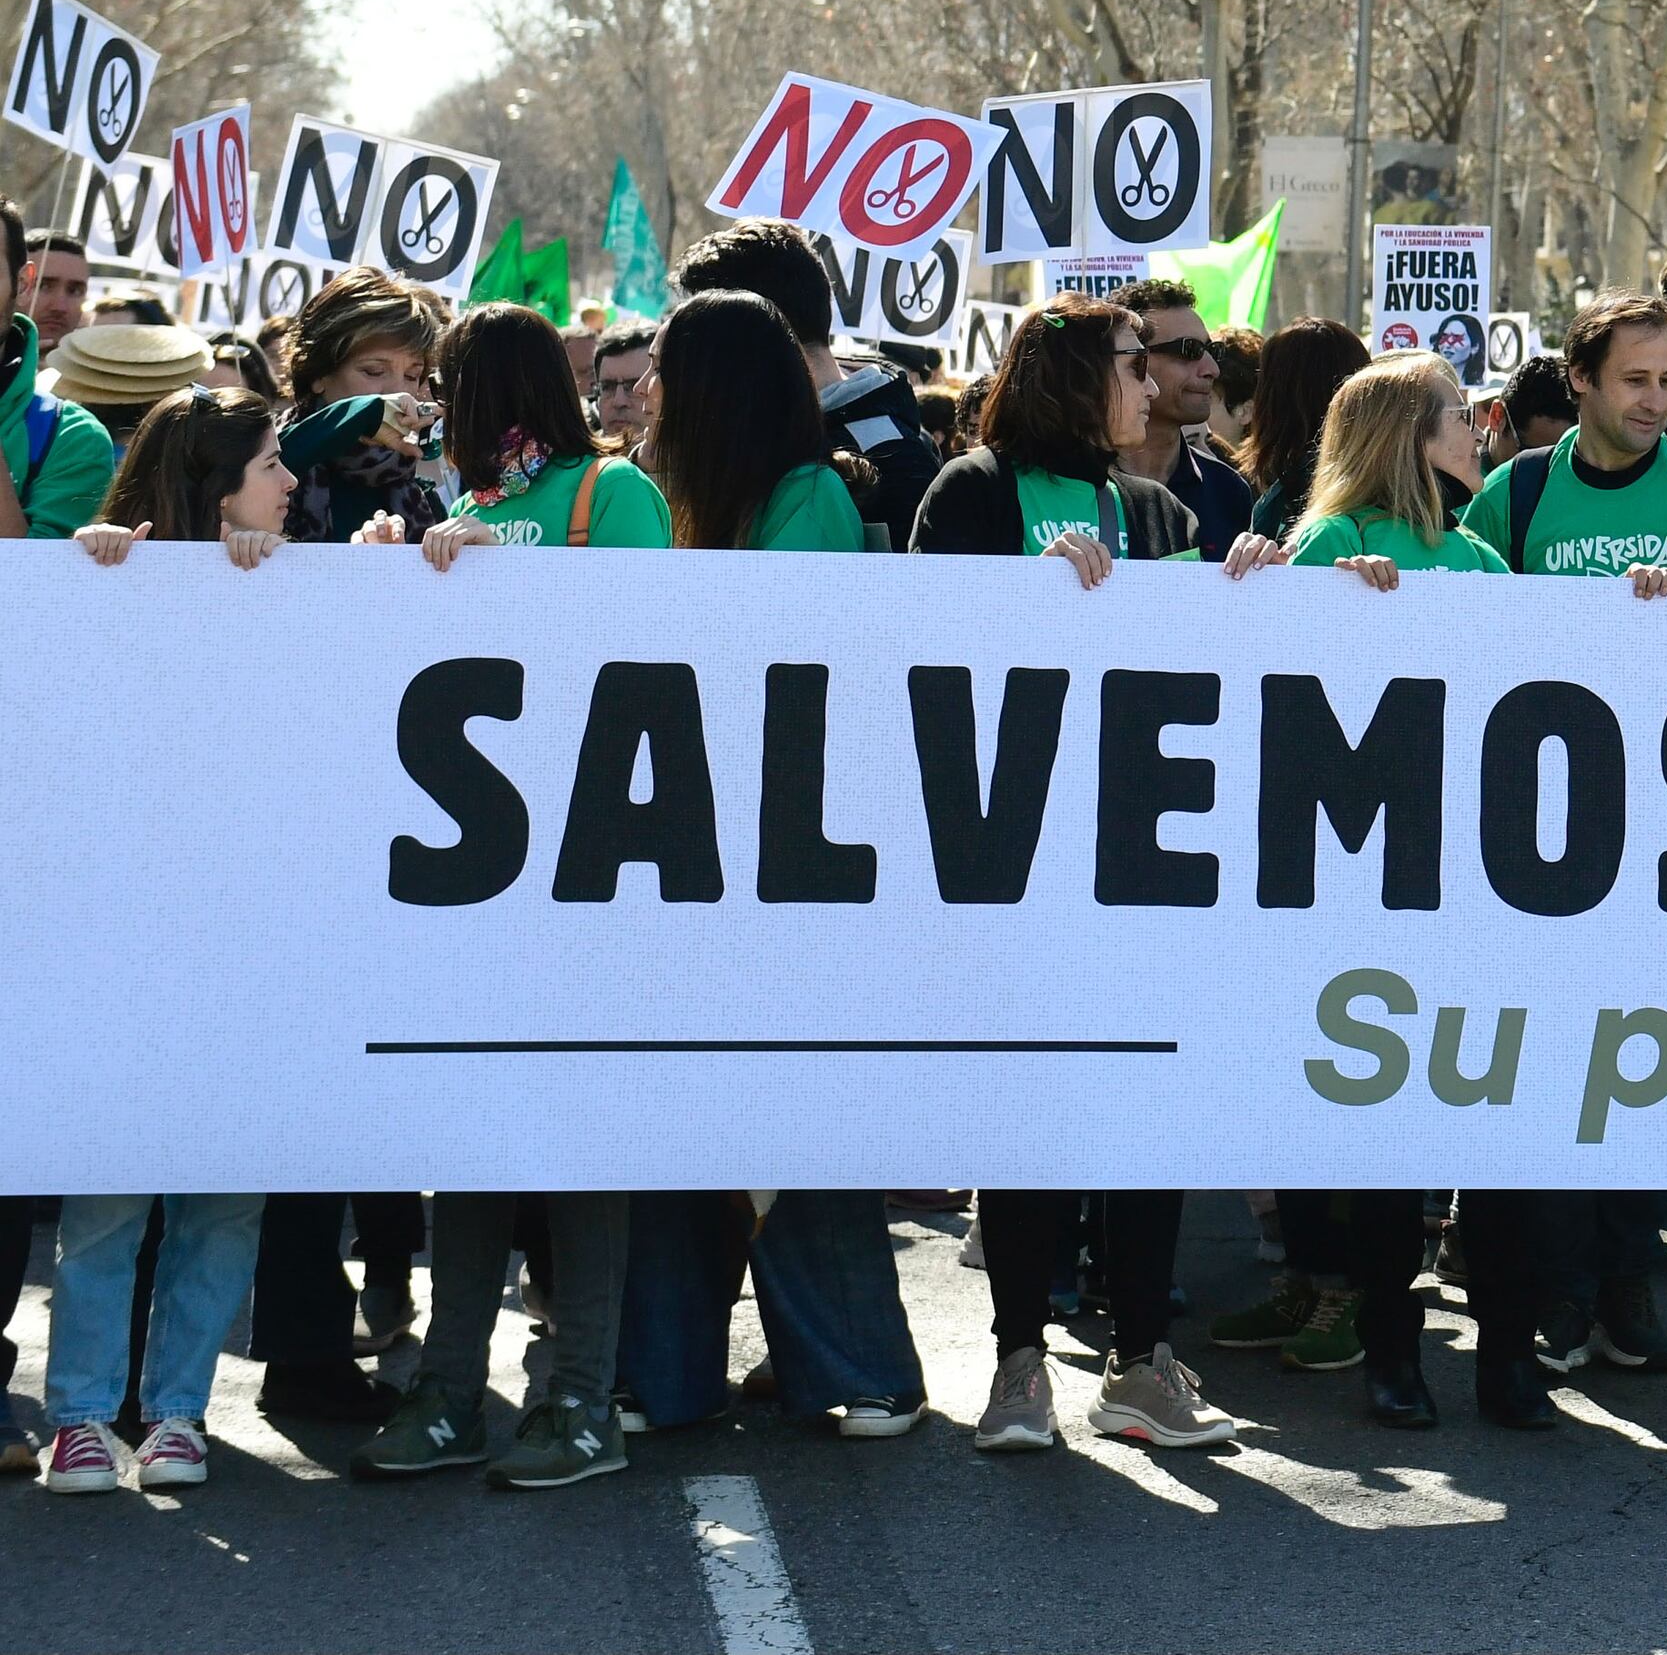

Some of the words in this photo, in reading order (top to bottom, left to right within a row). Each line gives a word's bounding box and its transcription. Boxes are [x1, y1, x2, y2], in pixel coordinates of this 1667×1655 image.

[172, 117, 248, 263] NO
[274, 127, 478, 281] NO
[718, 84, 973, 246] NO
[985, 92, 1200, 254] NO
[199, 258, 312, 325] NO
[808, 230, 959, 337] NO
[1384, 283, 1479, 312] AYUSO!
[1386, 250, 1477, 282] ¡FUERA
[1304, 968, 1527, 1106] Su
